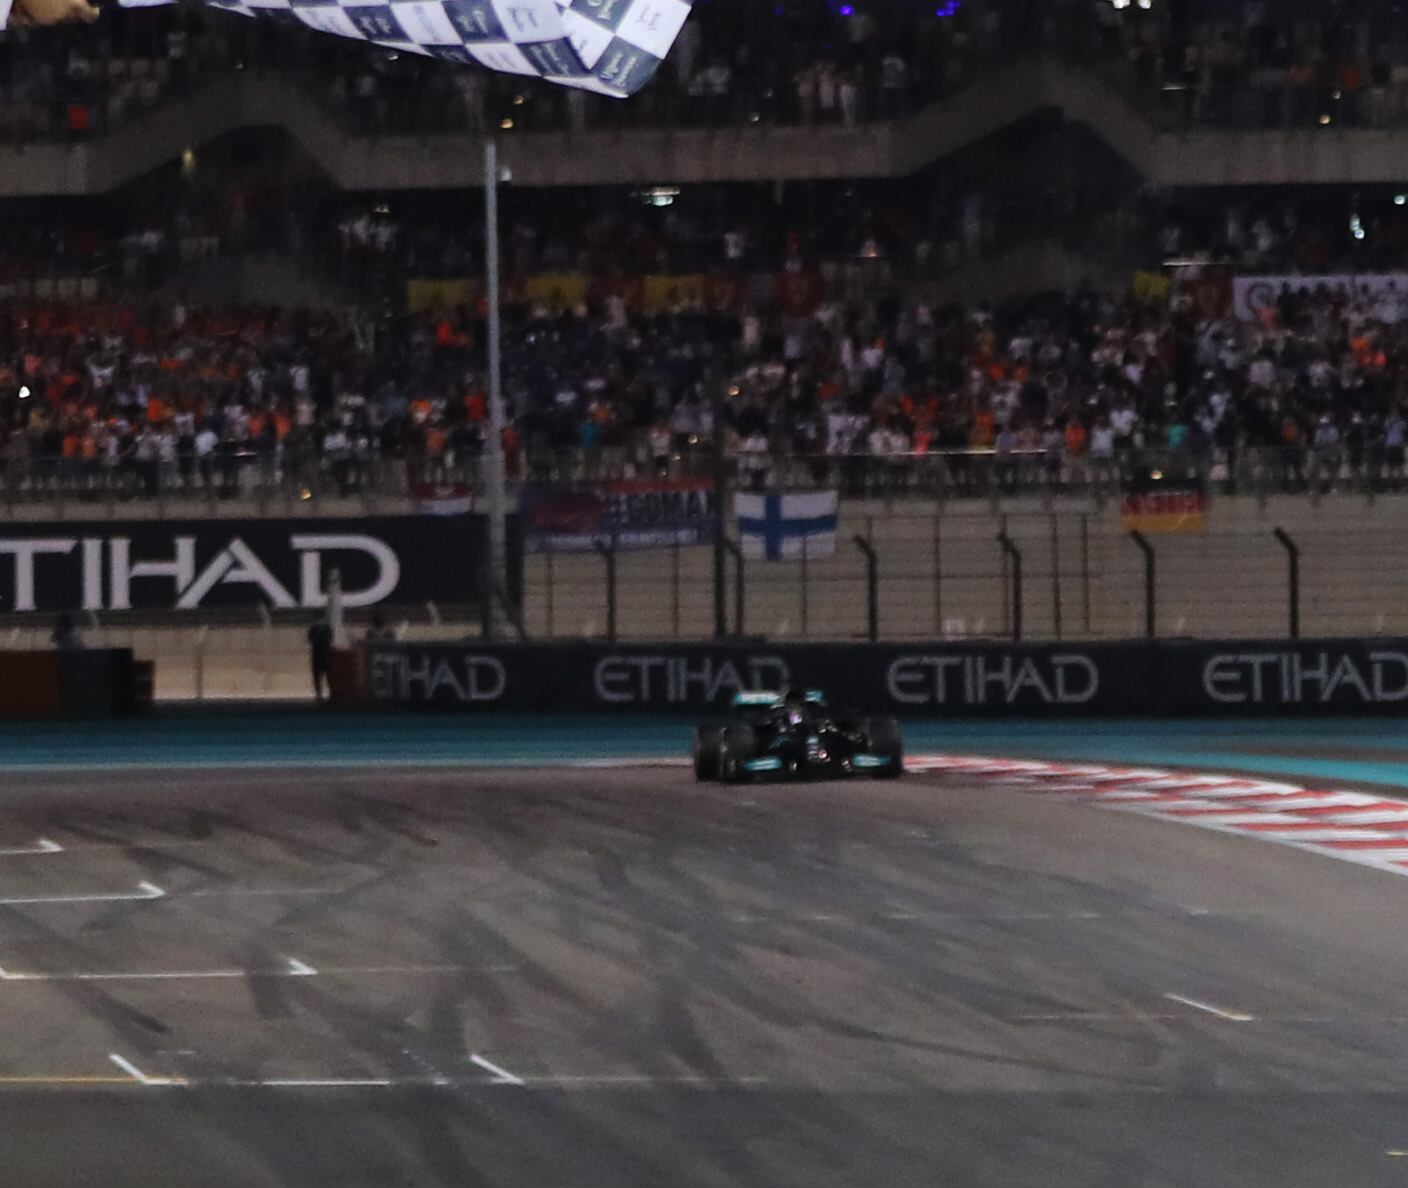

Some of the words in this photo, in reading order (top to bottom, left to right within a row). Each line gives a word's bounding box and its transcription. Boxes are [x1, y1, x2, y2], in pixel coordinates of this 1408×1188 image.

[0, 534, 400, 611] TIHAD
[594, 656, 790, 701] ETIHAD
[887, 655, 1099, 703] ETIHAD
